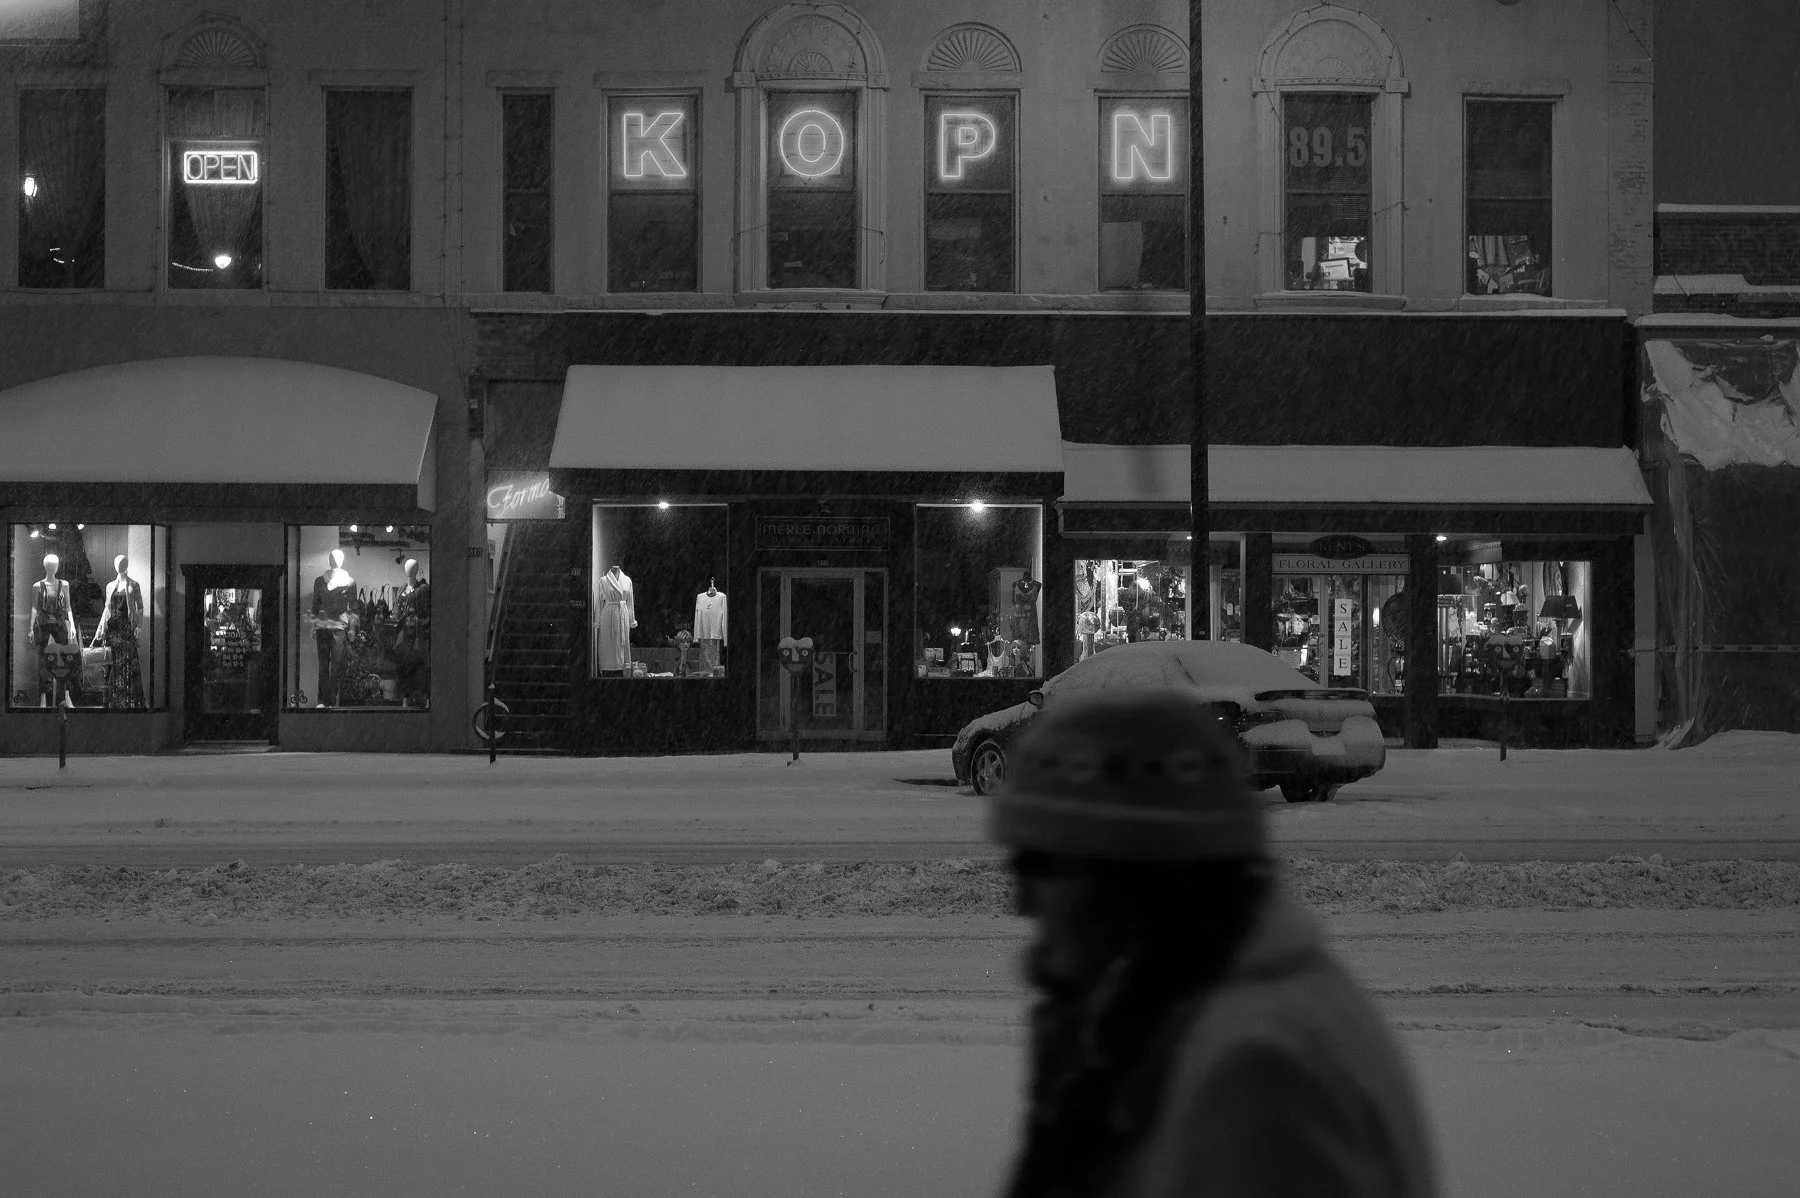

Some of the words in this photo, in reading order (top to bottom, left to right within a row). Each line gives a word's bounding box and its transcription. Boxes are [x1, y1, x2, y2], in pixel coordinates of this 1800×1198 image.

[1289, 126, 1368, 168] 89.5
[187, 154, 254, 180] OPEN
[1279, 558, 1336, 570] FLORAL
[1342, 558, 1406, 570] GALLERY
[814, 652, 835, 715] SALE
